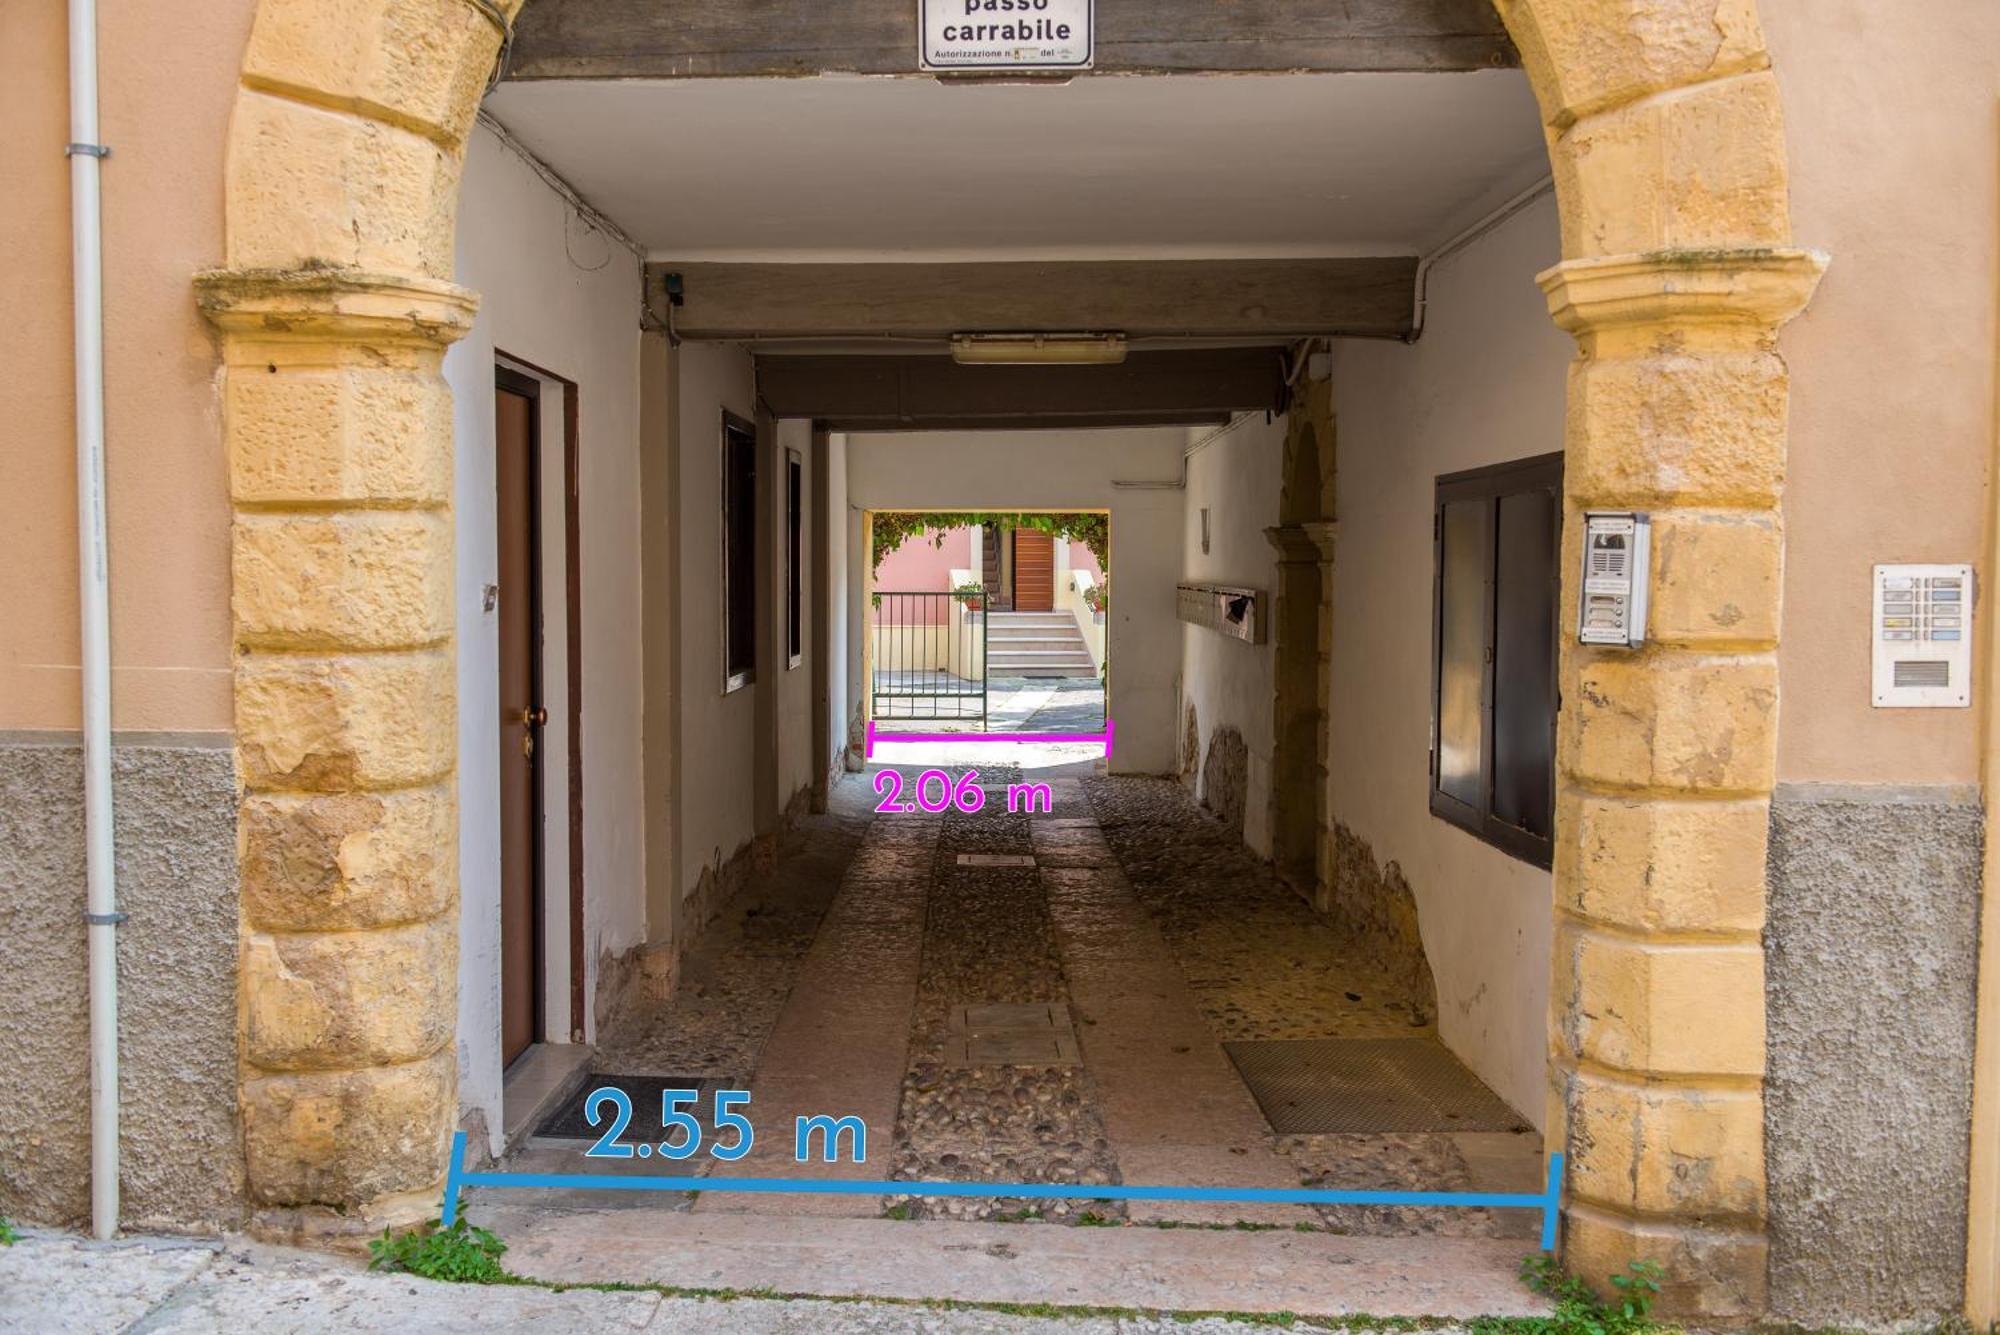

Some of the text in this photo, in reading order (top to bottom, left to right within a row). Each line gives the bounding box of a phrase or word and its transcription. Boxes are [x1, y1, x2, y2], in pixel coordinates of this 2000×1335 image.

[964, 0, 1048, 15] passo
[943, 19, 1071, 41] carrabile
[935, 49, 1002, 58] Autorizzazione
[1041, 49, 1054, 57] del
